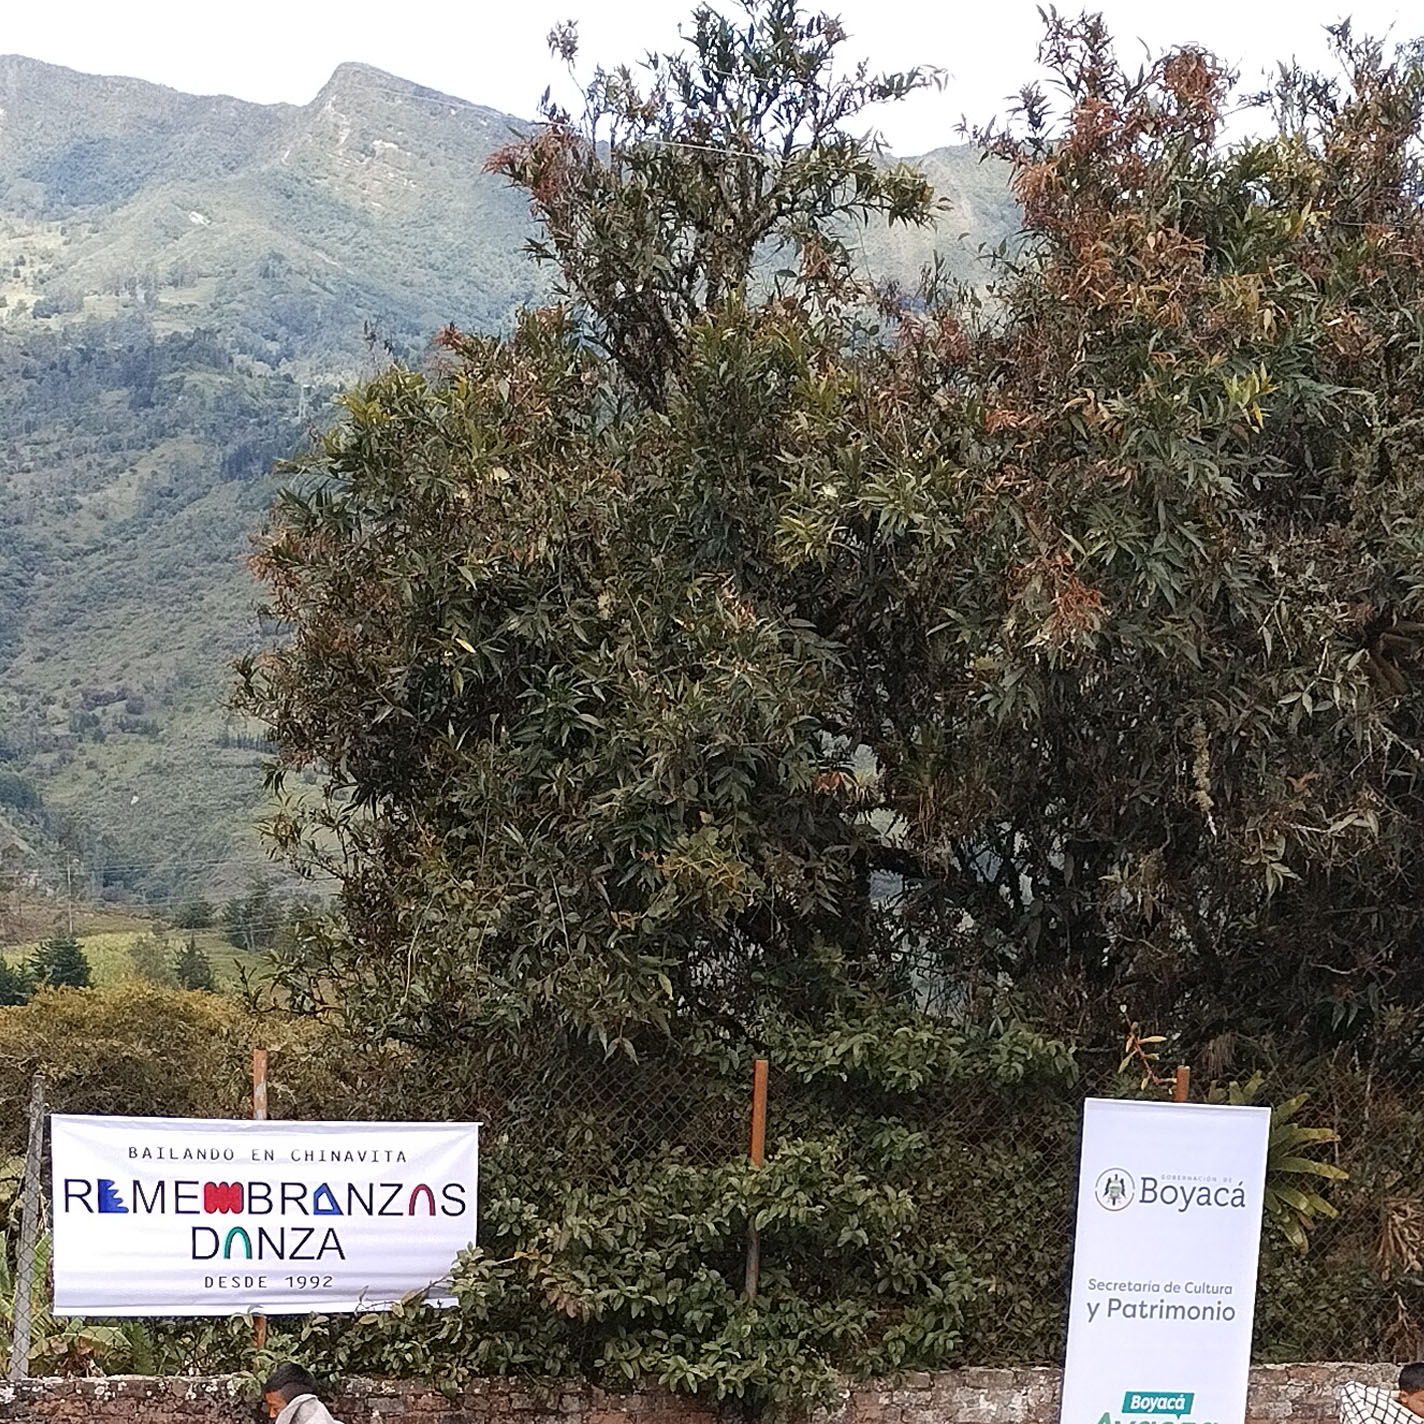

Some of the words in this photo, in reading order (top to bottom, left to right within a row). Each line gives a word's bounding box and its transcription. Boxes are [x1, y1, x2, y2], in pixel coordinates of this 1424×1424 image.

[128, 1146, 235, 1161] BAILANDO
[251, 1149, 275, 1161] EN
[290, 1148, 407, 1163] CHINAVITA
[63, 1178, 466, 1217] REMEMBRANZAS
[1139, 1177, 1246, 1213] Boyacá
[191, 1225, 346, 1260] DANZA
[204, 1276, 268, 1289] DESDE
[286, 1275, 334, 1289] 1992
[1163, 1281, 1182, 1295] de
[1184, 1280, 1233, 1296] Cultura
[1086, 1301, 1101, 1323] y
[1106, 1297, 1236, 1322] Patrimonio
[1130, 1393, 1186, 1413] Boyacá
